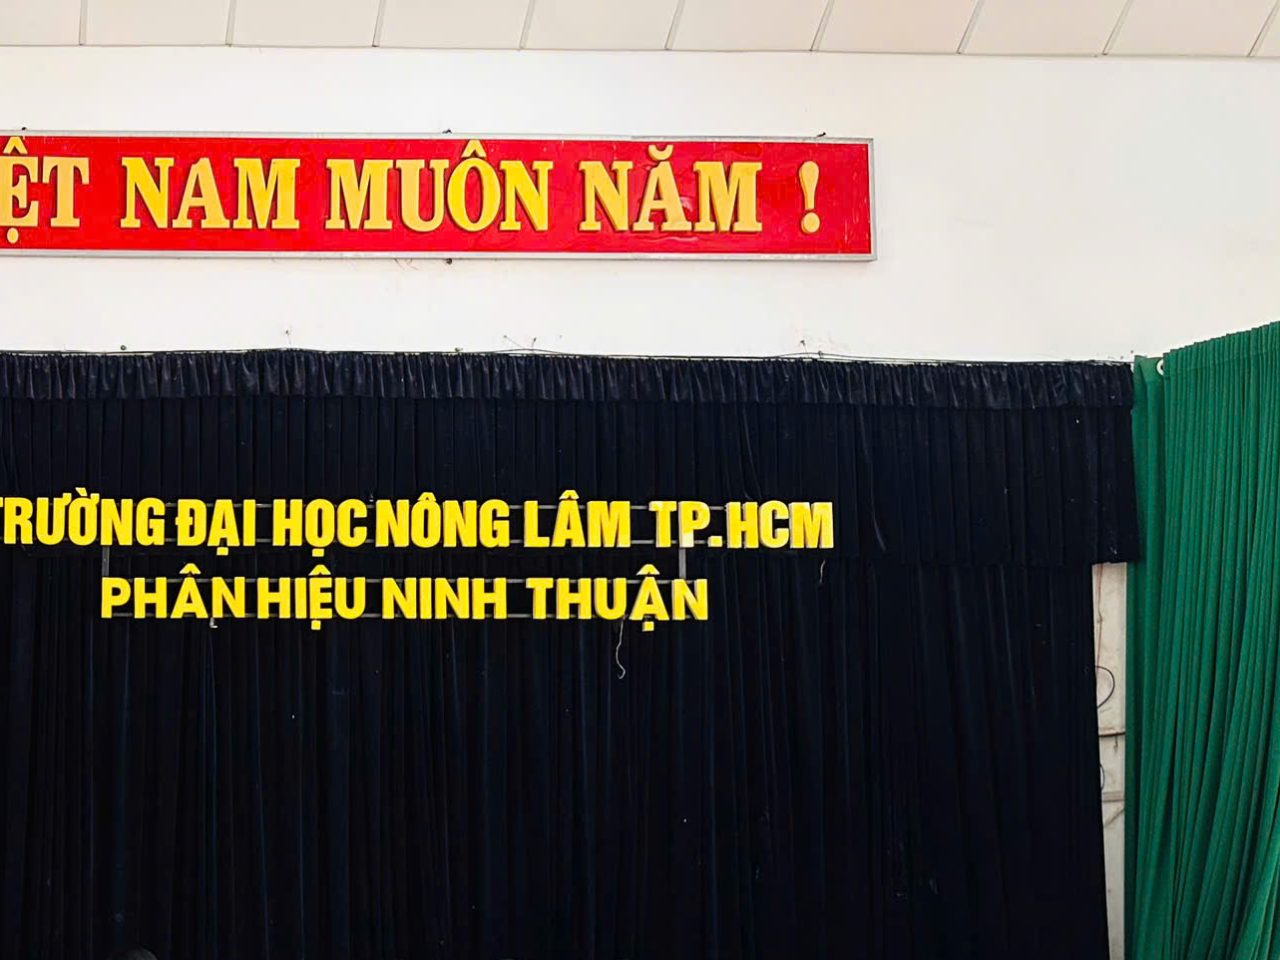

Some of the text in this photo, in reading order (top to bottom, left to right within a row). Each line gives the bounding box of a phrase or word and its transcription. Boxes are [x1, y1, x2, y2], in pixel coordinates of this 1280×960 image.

[120, 156, 301, 229] NAM
[325, 139, 554, 232] MUÔN
[579, 145, 763, 232] NĂM
[175, 498, 257, 556] ĐẠI
[272, 498, 368, 557] HỌC
[375, 492, 510, 548] NÔNG
[523, 490, 632, 548] LÂM
[649, 500, 833, 549] TP.HCM
[101, 564, 709, 632] PHÂN HIỆU NINH THUẬN
